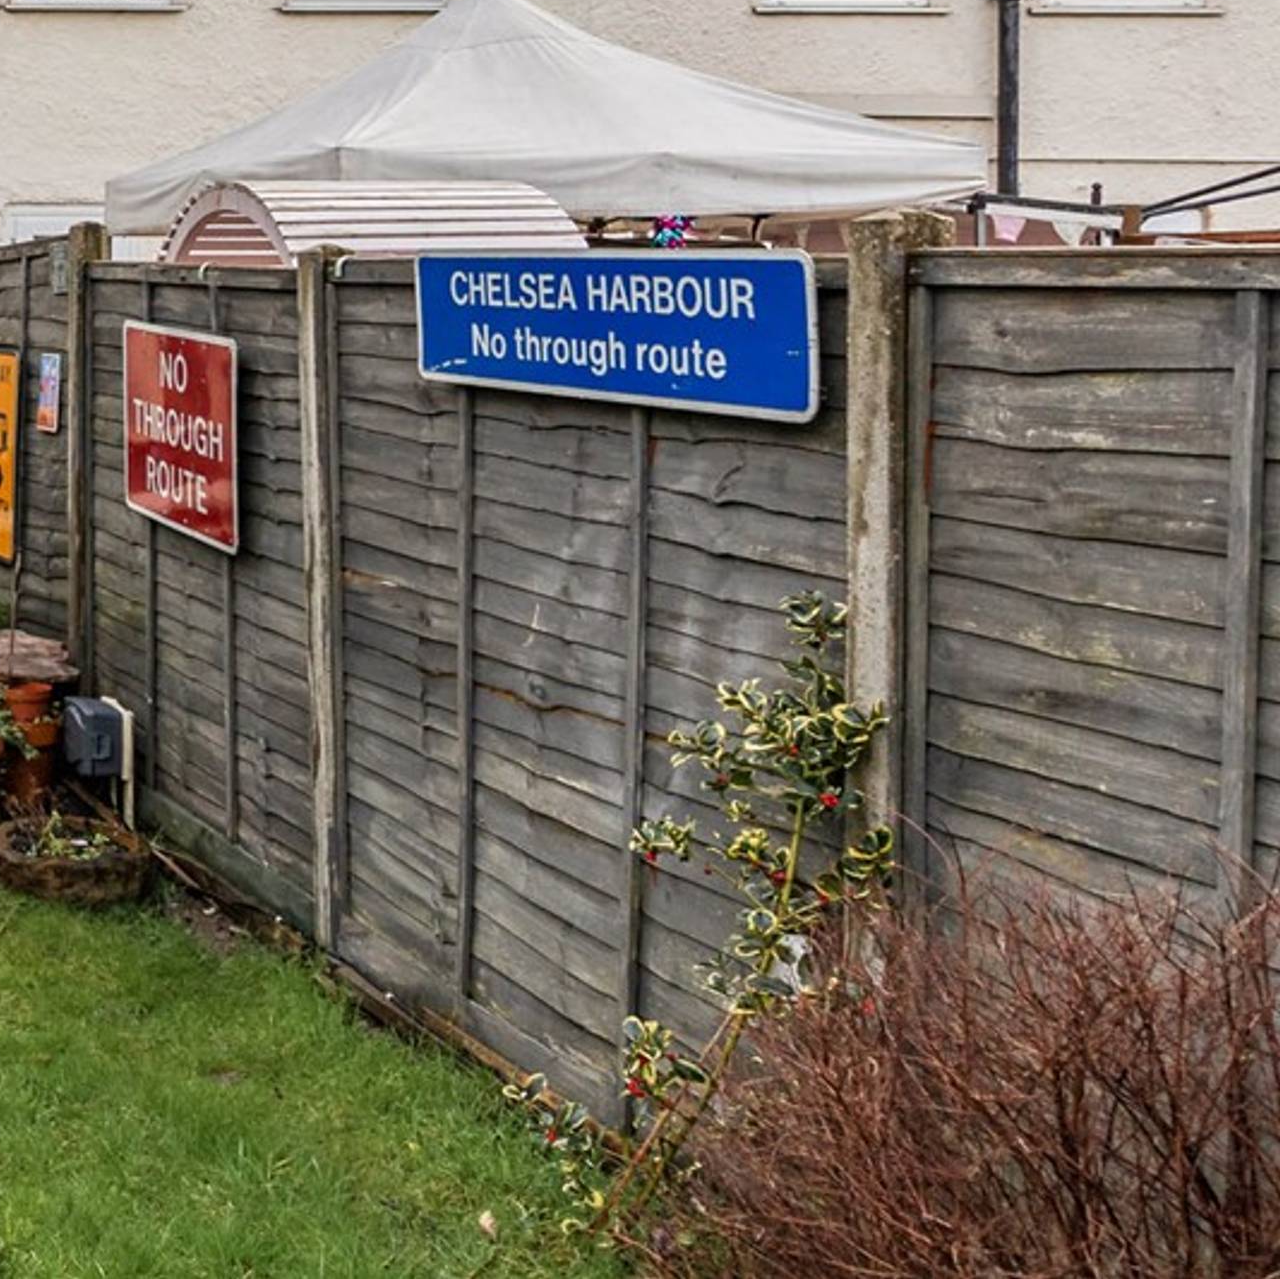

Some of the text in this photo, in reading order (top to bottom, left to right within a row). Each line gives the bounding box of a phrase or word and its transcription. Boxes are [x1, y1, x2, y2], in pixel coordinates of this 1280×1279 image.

[449, 270, 756, 320] CHELSEA HARBOUR
[158, 350, 188, 394] NO
[470, 322, 728, 380] No through route
[132, 398, 224, 462] THROUGH
[145, 456, 209, 515] ROUTE
